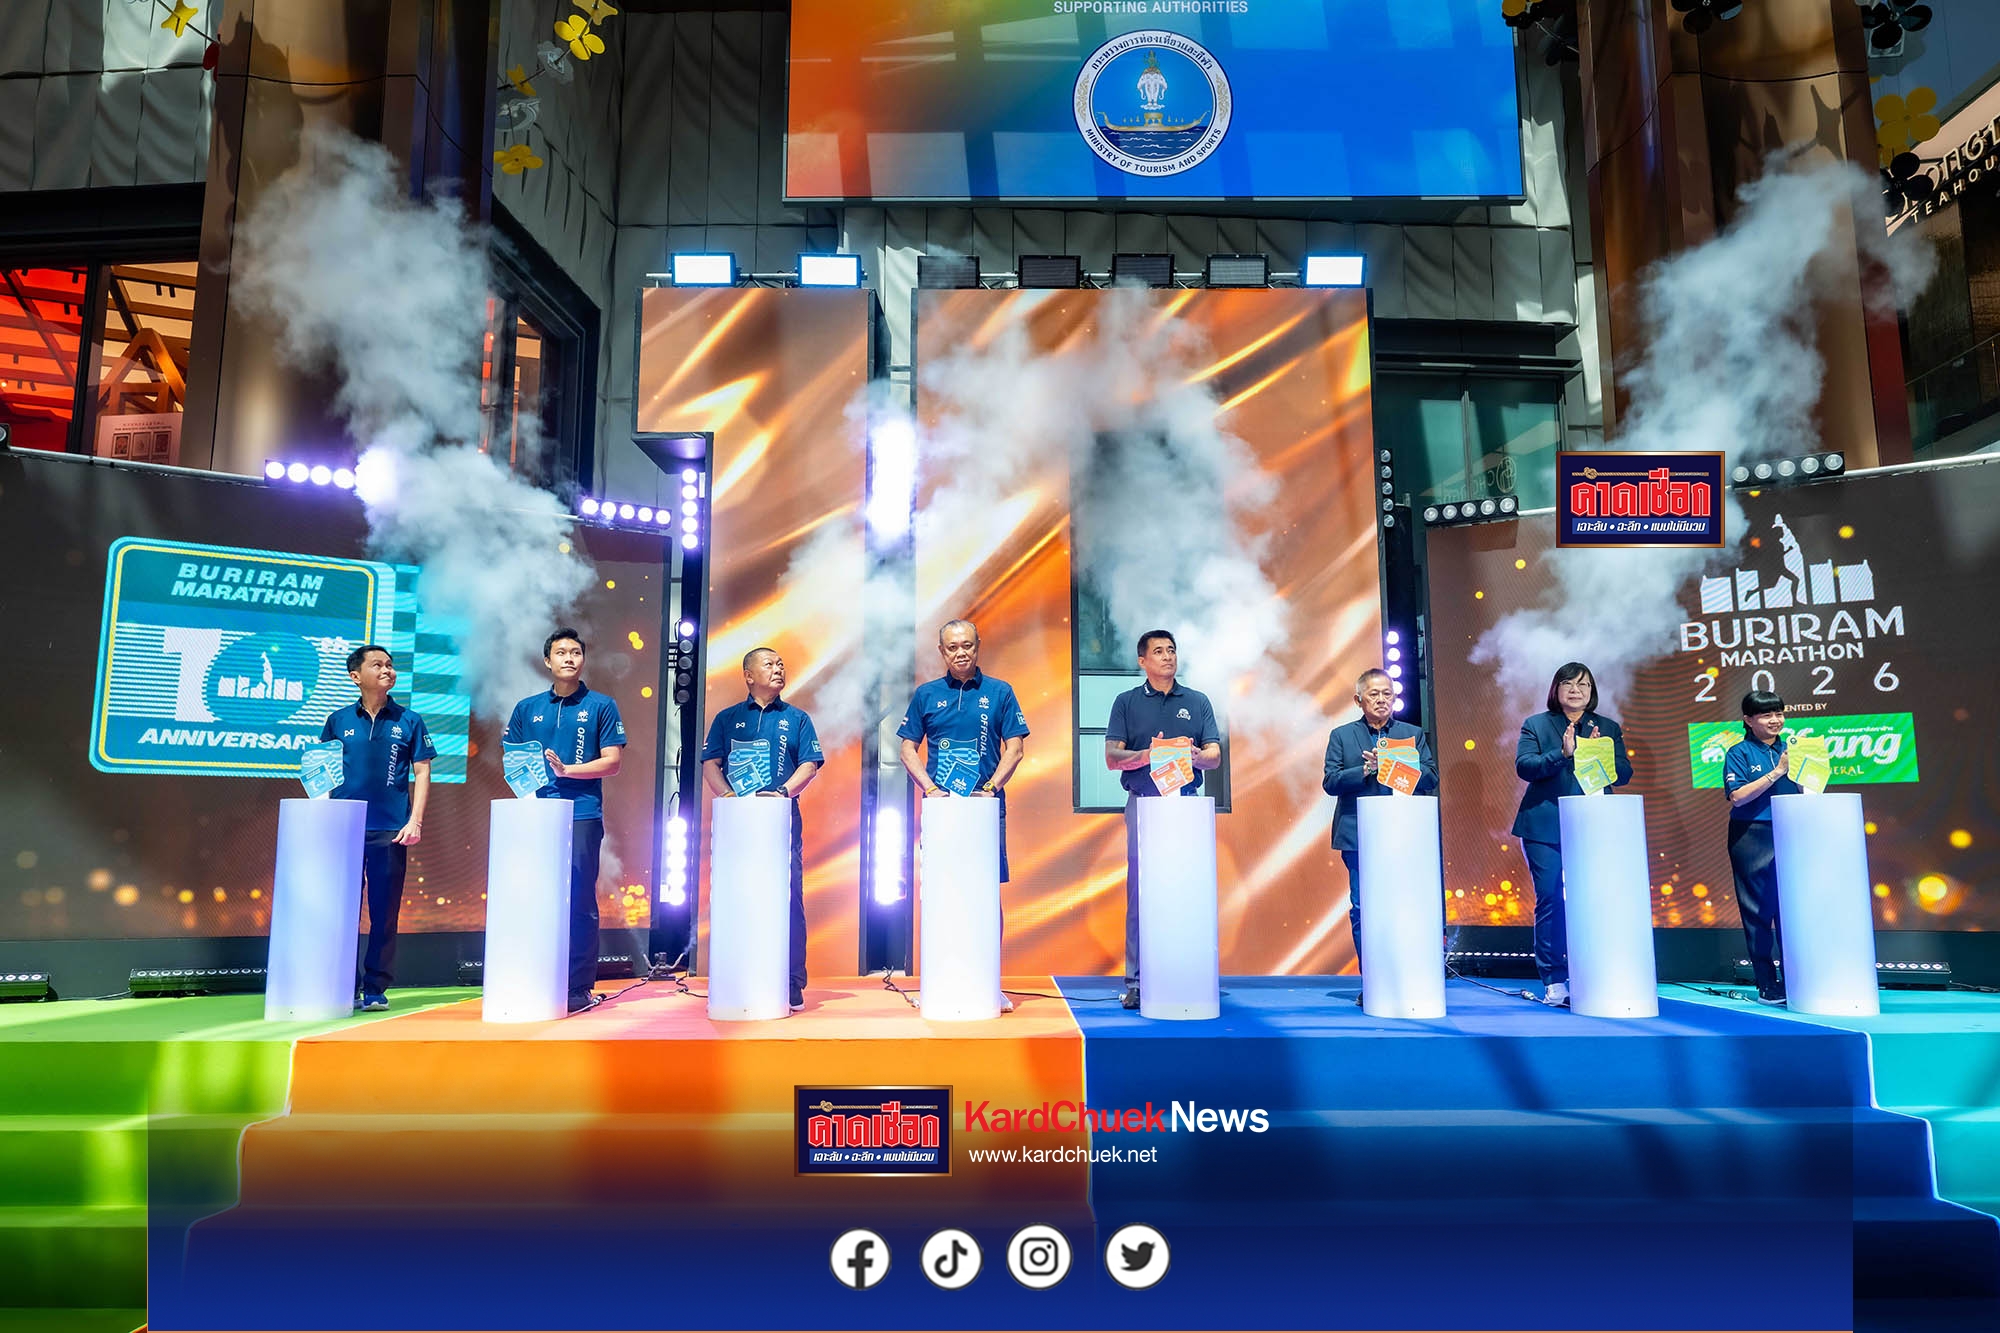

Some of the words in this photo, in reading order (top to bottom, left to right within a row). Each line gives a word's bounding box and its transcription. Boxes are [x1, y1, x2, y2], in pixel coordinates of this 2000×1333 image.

[1053, 1, 1147, 13] SUPPORTING
[1152, 1, 1249, 13] AUTHORITIES
[1091, 33, 1213, 70] กระทรวงการท่องเที่ยวและกีฬา
[1085, 128, 1119, 162] MINISTRY
[1120, 160, 1132, 169] OF
[1134, 163, 1176, 173] TOURISM
[1178, 155, 1197, 169] AND
[1196, 128, 1222, 158] SPORTS
[171, 580, 319, 608] MARATHON
[177, 562, 324, 591] BURIRAM
[1680, 605, 1905, 652] BURIRAM
[1721, 641, 1865, 668] MARATHON
[1784, 703, 1813, 713] ENTED
[1815, 702, 1828, 711] BY
[575, 727, 586, 764] OFFICIA
[980, 713, 988, 757] OFFICIAL
[386, 743, 399, 787] OFFICIAL
[777, 734, 788, 777] OFFICIAL
